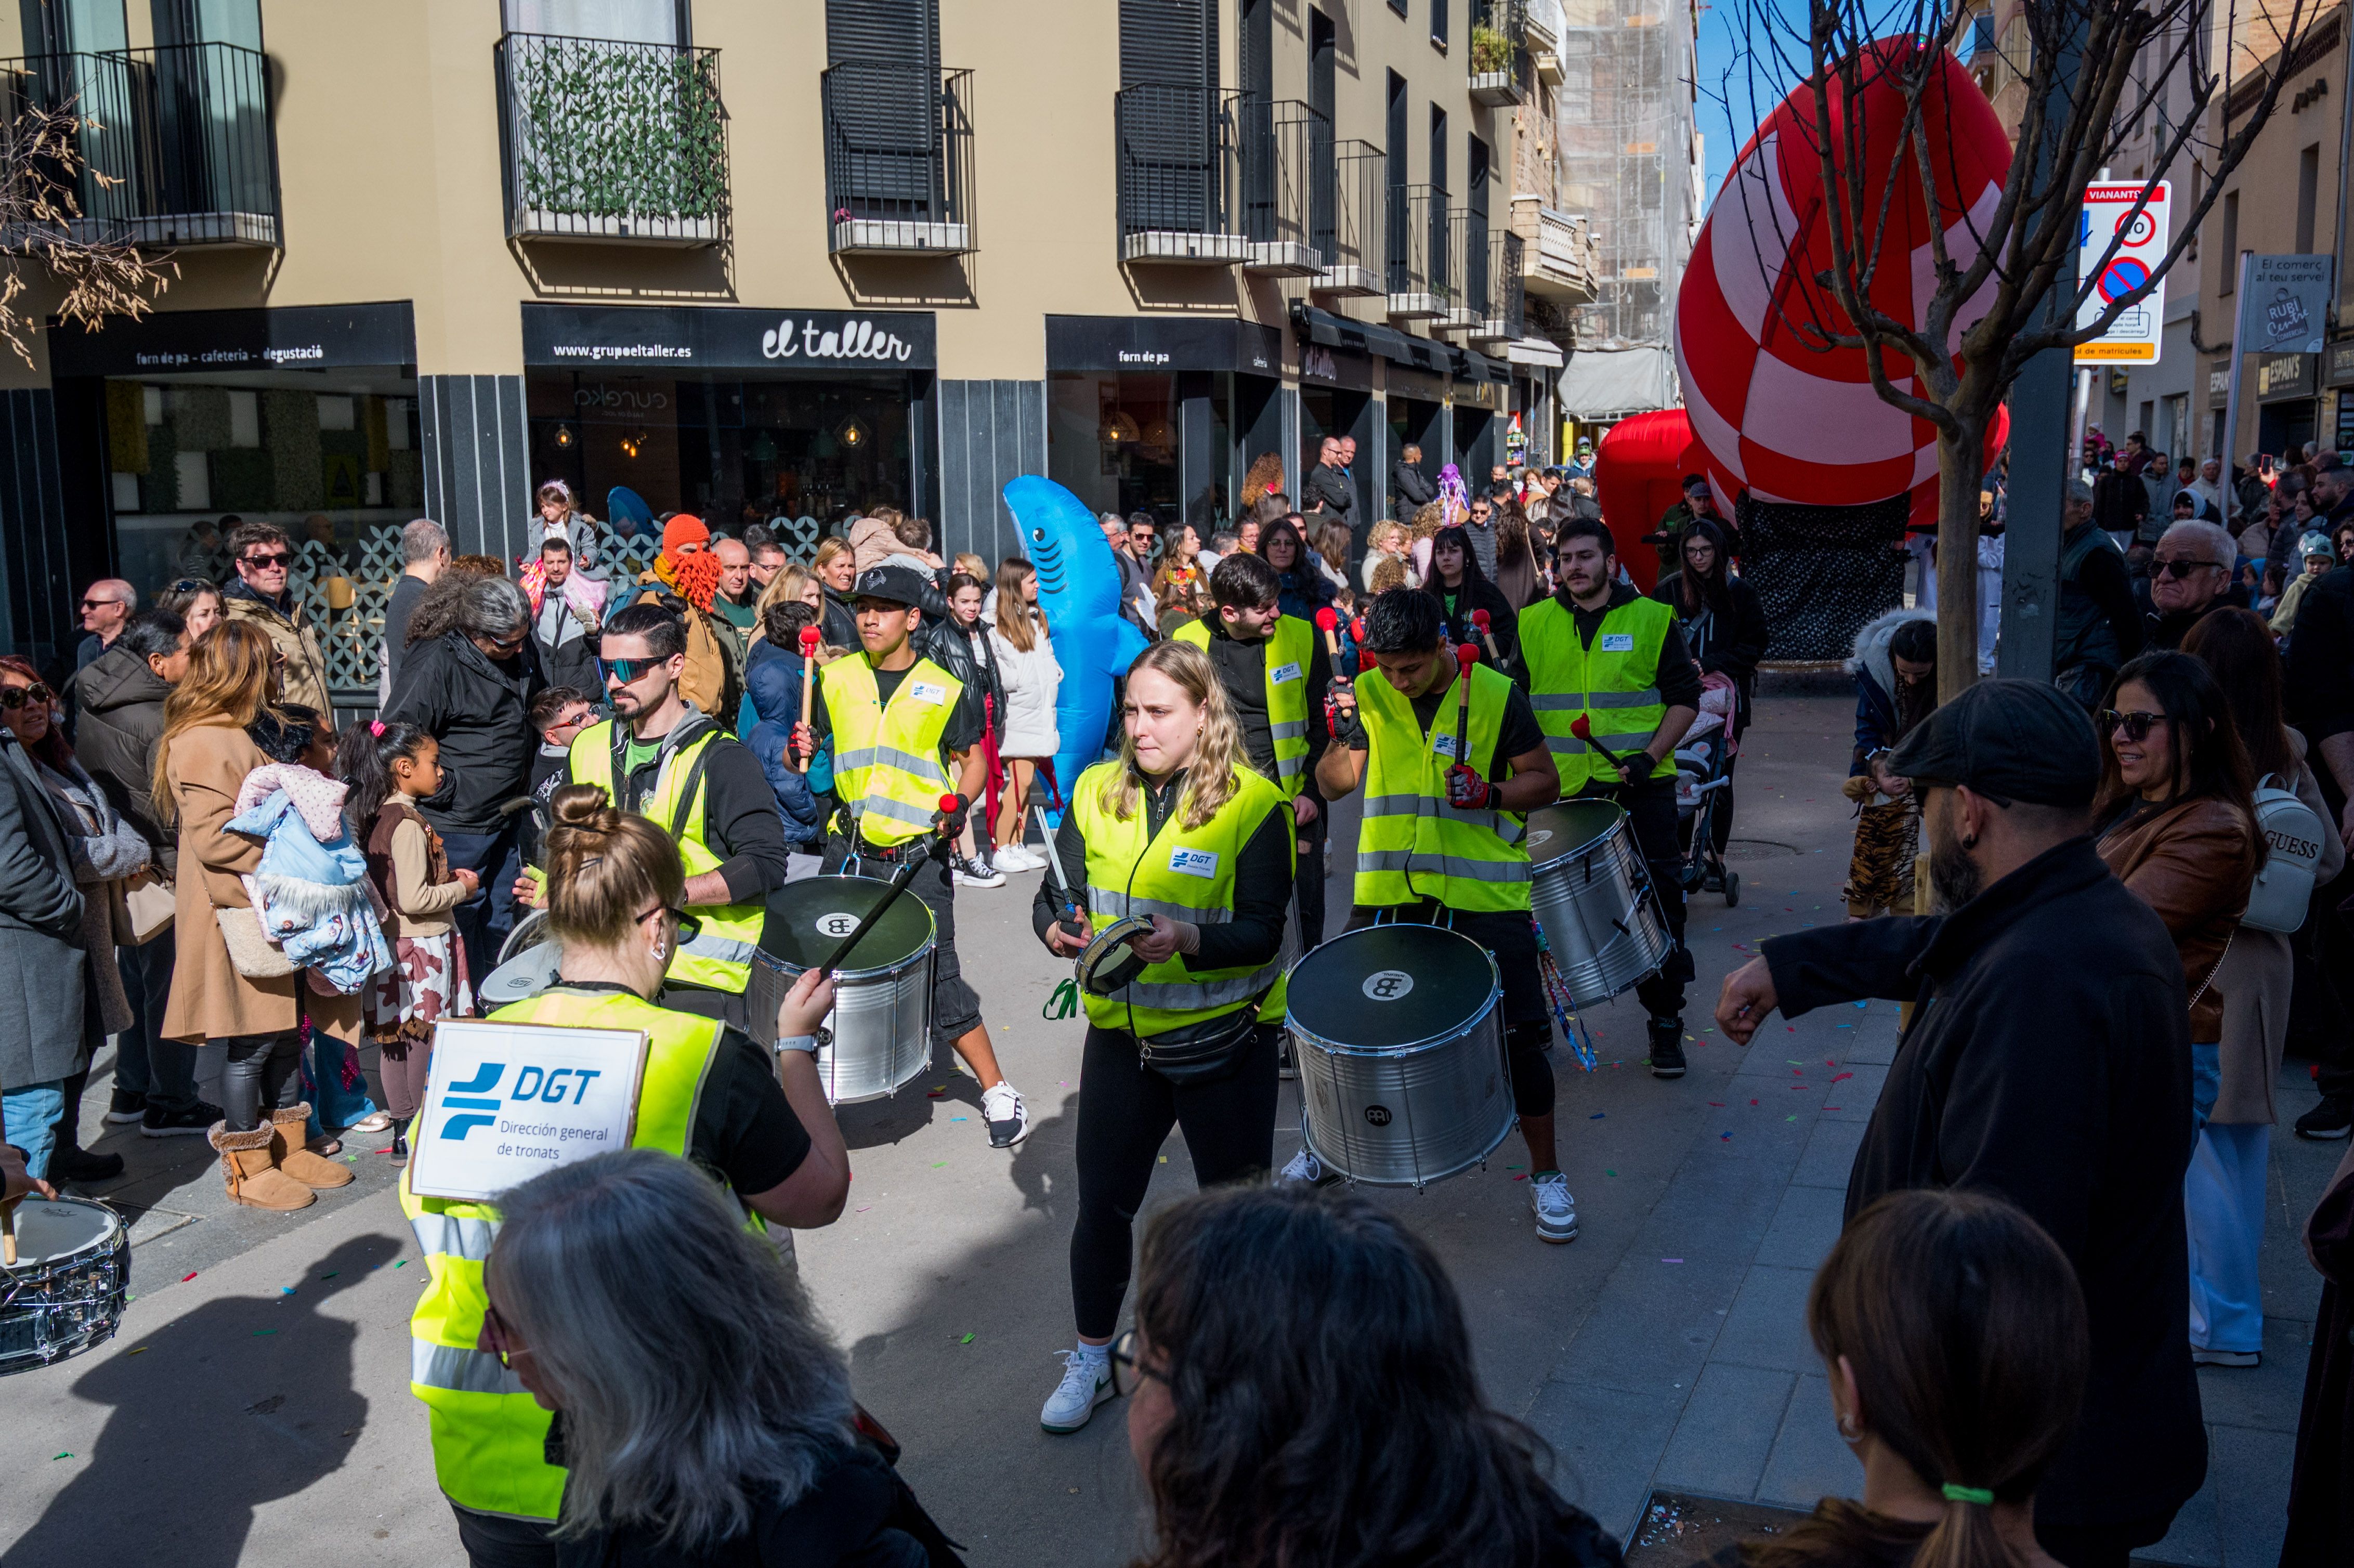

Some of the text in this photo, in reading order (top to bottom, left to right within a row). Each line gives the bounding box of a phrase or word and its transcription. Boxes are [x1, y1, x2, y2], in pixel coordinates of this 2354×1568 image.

[2089, 190, 2141, 199] VIANANTS
[2262, 259, 2322, 271] El comerç
[2256, 273, 2265, 282] al
[2291, 273, 2324, 282] servei
[2267, 309, 2309, 336] Centre
[763, 319, 912, 361] el taller
[136, 353, 158, 365] forn
[161, 352, 174, 364] de
[176, 354, 189, 366] pa
[201, 348, 249, 362] cafeteria
[263, 345, 323, 363] degustació
[554, 344, 691, 360] www.grupoeltaller.es
[1119, 350, 1169, 365] forn de pa
[2211, 370, 2230, 393] ESPAN
[1283, 665, 1294, 674] DGT
[2265, 830, 2319, 859] GUESS
[1190, 854, 1211, 864] DGT
[511, 1066, 601, 1105] DGT
[500, 1120, 608, 1141] Dirección general
[497, 1142, 559, 1159] de tronats
